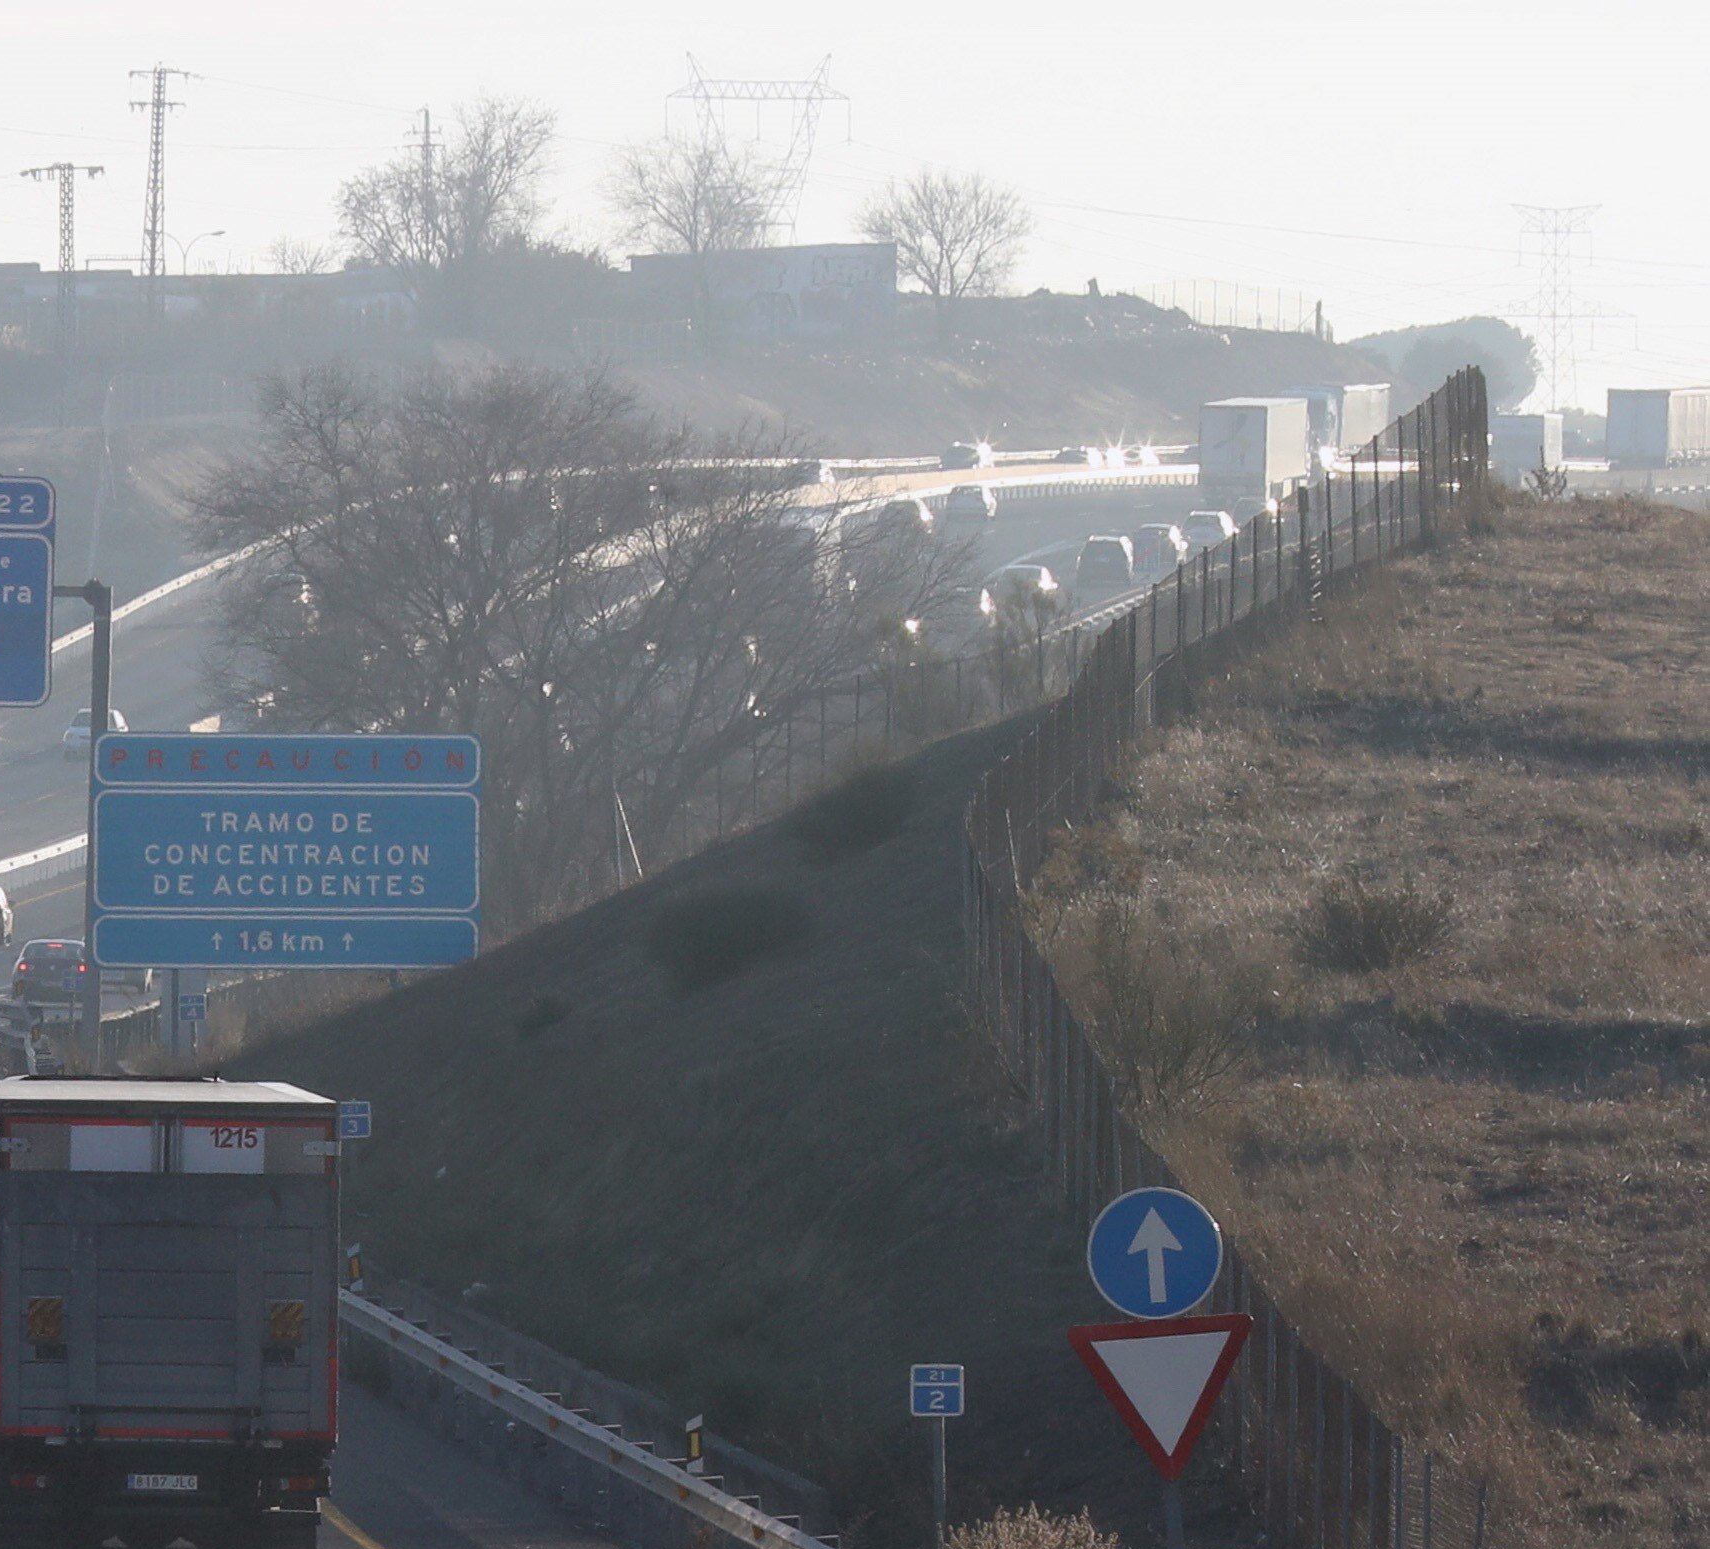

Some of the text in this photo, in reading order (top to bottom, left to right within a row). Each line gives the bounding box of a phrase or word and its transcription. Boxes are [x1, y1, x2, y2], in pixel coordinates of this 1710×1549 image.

[110, 745, 466, 772] PRECAUCIÓN
[201, 812, 373, 833] TRAMO DE
[144, 844, 430, 866] CONCENTRACION
[154, 874, 426, 897] DE ACCIDENTES
[239, 930, 324, 953] 1,6 km
[348, 1120, 358, 1134] 3
[210, 1128, 258, 1149] 1215
[929, 1370, 945, 1381] 21
[929, 1390, 945, 1410] 2
